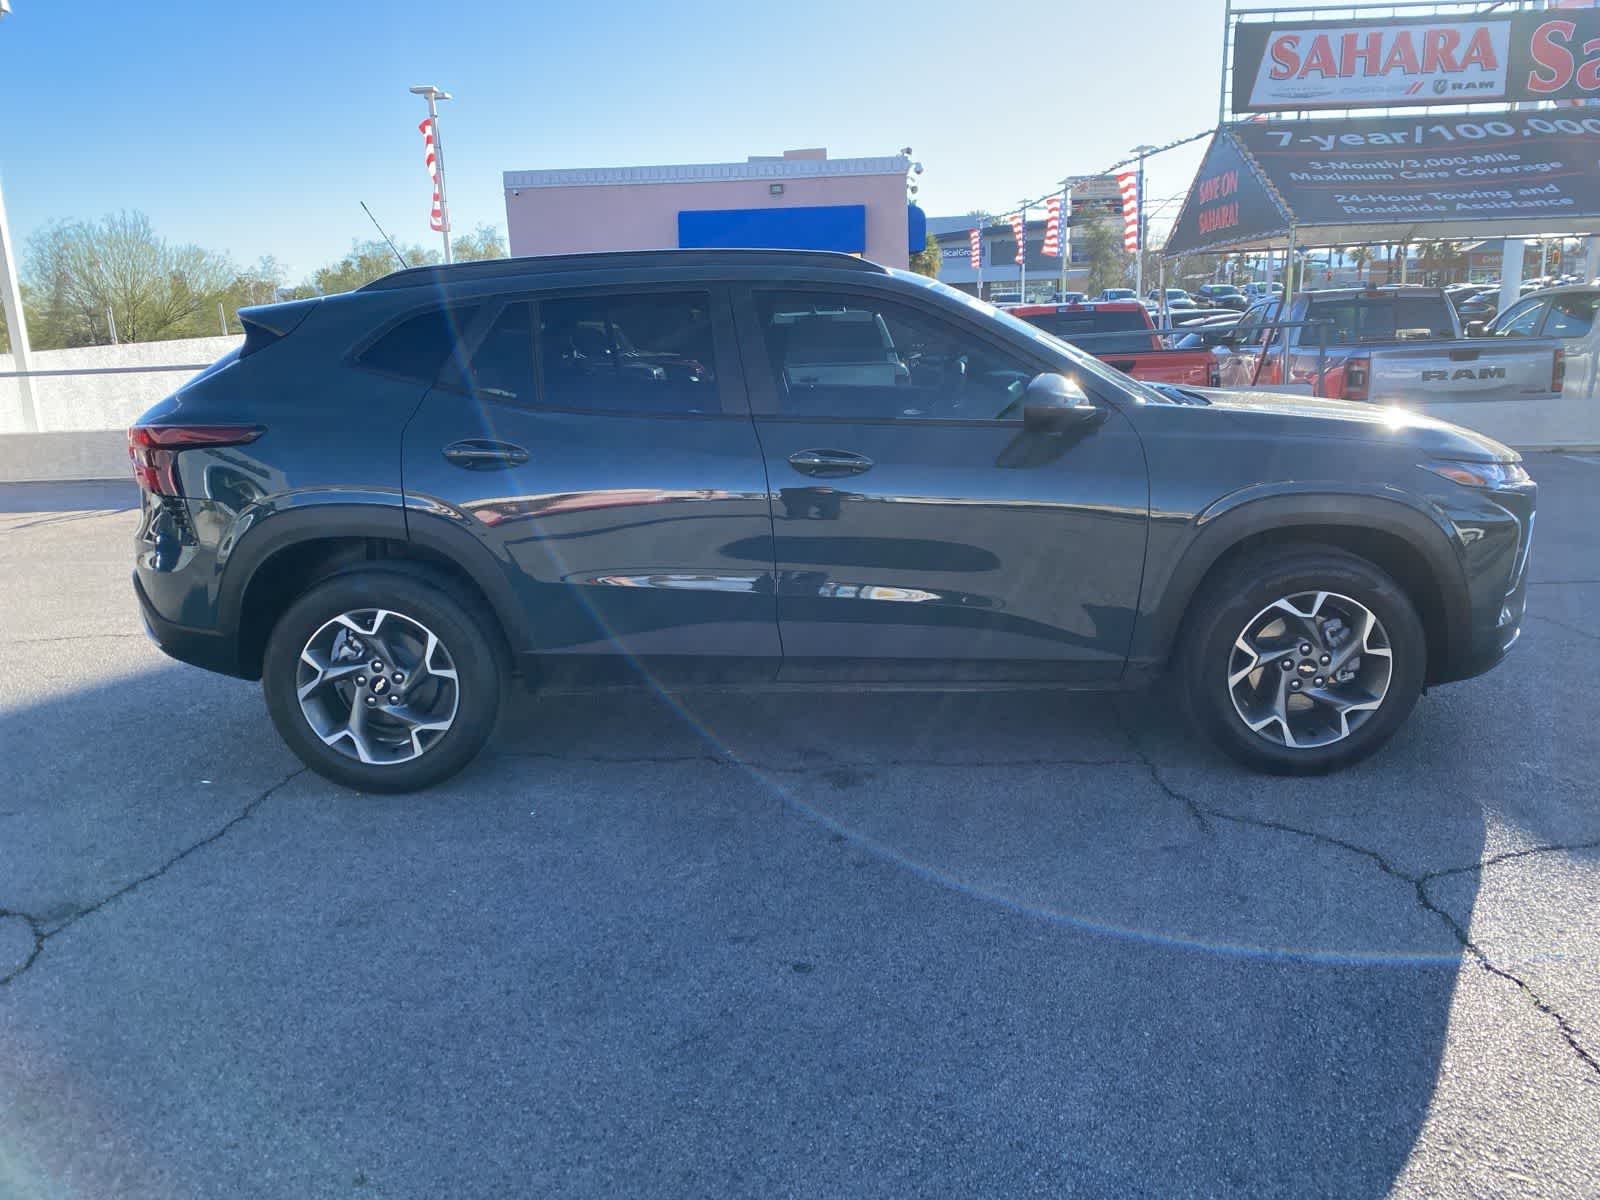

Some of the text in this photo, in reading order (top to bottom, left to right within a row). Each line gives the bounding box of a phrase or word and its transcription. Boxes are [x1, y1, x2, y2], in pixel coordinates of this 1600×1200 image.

[1269, 26, 1499, 80] SAHARA
[1452, 80, 1495, 90] RAM
[1289, 160, 1564, 183] Maximum Care Coverage
[1333, 183, 1560, 204] 24-Hour Towing and
[1343, 197, 1576, 215] Roadside Assistance
[1422, 367, 1506, 381] RAM
